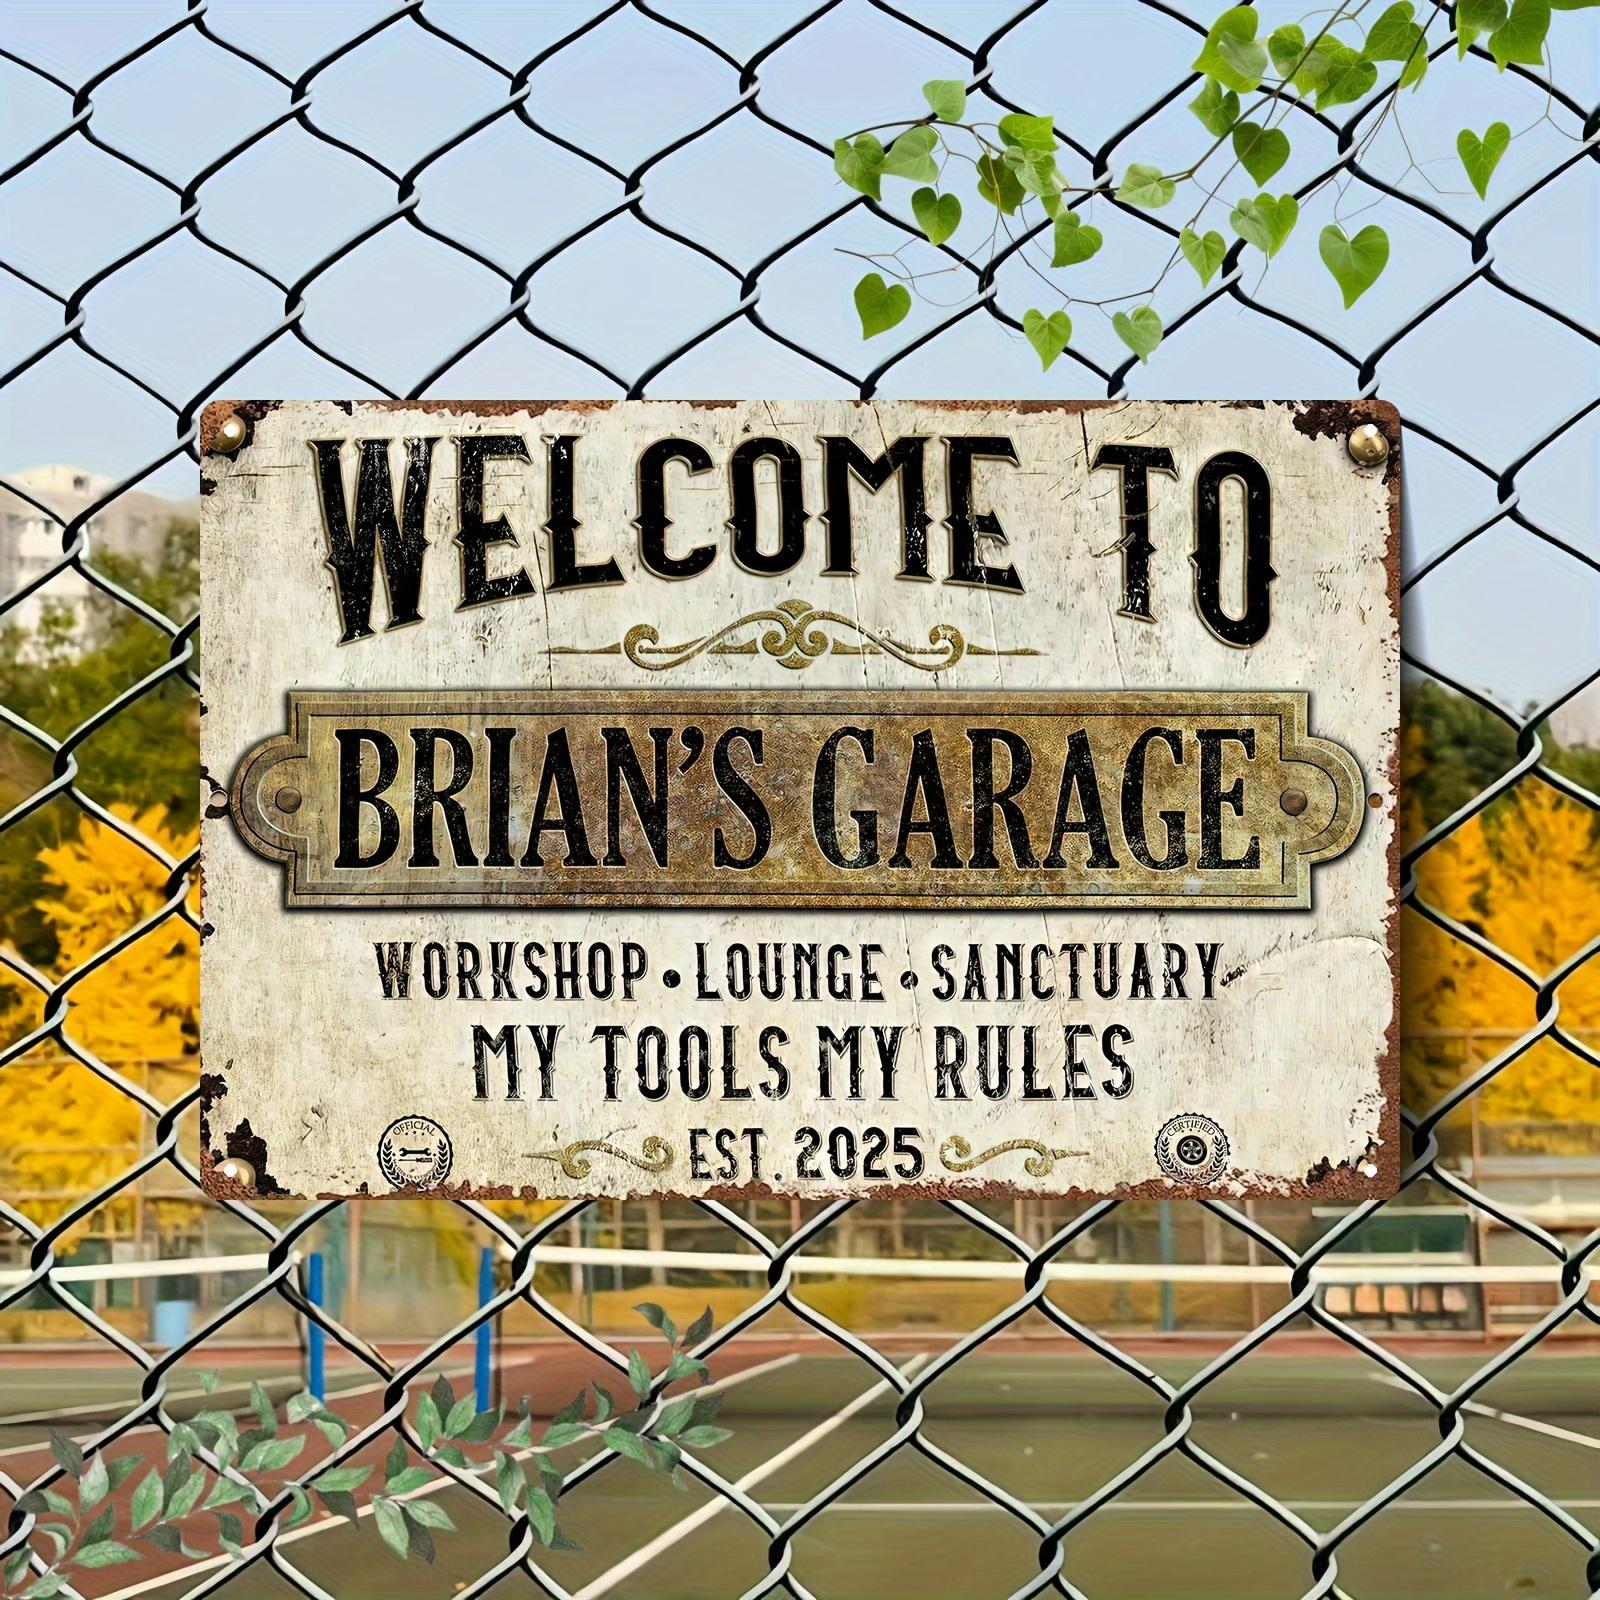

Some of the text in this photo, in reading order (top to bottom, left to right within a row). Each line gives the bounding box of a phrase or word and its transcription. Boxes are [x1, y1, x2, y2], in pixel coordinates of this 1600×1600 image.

[306, 434, 1280, 650] WELCOME TO
[333, 726, 1262, 870] BRIAN'S GARAGE
[373, 941, 1226, 1002] WORKSHOP LOUNGE SANCTUARY
[470, 1024, 1136, 1102] MY TOOLS MY RULES
[392, 1120, 437, 1137] OFFICIAL
[687, 1126, 926, 1182] EST. 2025
[1166, 1119, 1217, 1137] CERTIFIED
